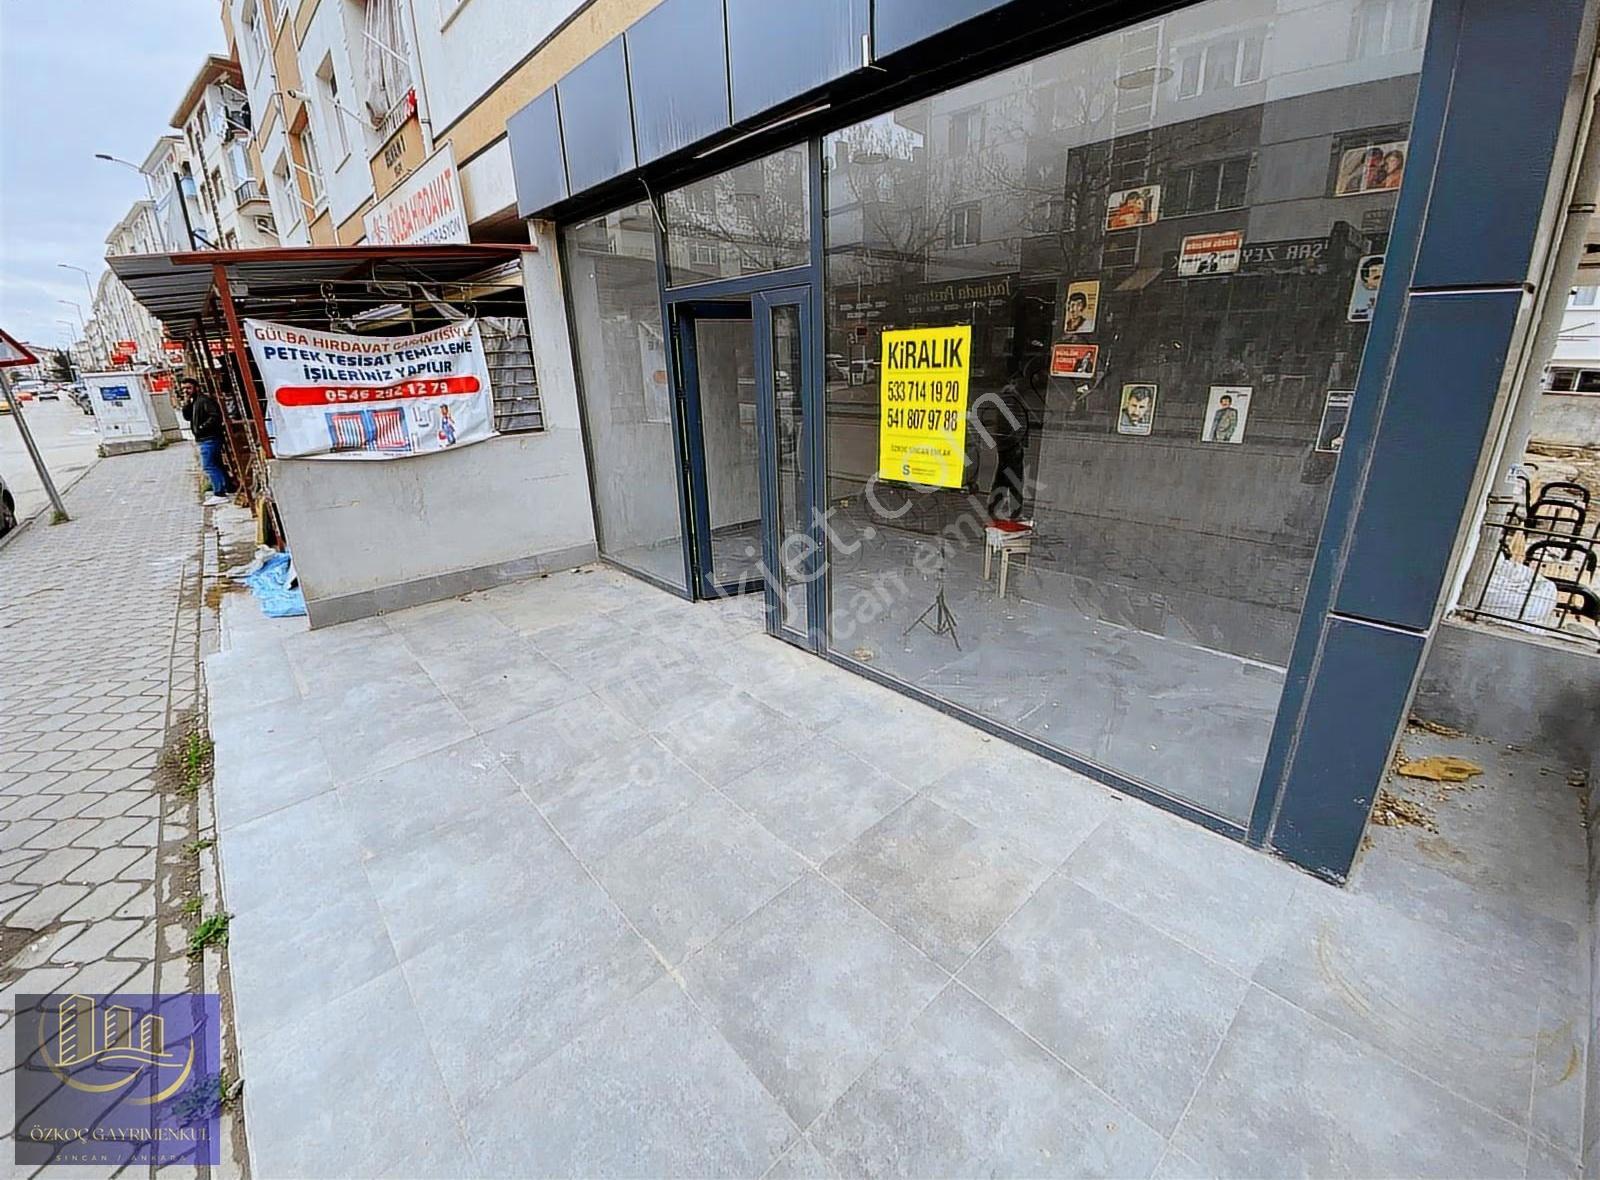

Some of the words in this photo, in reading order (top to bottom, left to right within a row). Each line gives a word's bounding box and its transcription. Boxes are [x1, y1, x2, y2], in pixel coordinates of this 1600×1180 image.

[254, 326, 308, 345] GÜLBA
[313, 337, 390, 353] HIRDAVAT
[264, 346, 323, 363] PETEK
[325, 353, 392, 367] TESİSAT
[395, 361, 452, 378] YAPILIR
[407, 383, 427, 395] 12
[888, 381, 905, 401] 533
[908, 381, 926, 402] 714
[930, 381, 942, 402] 19
[945, 381, 959, 403] 20
[887, 408, 904, 428] 541
[907, 409, 925, 429] 807
[927, 409, 942, 430] 97
